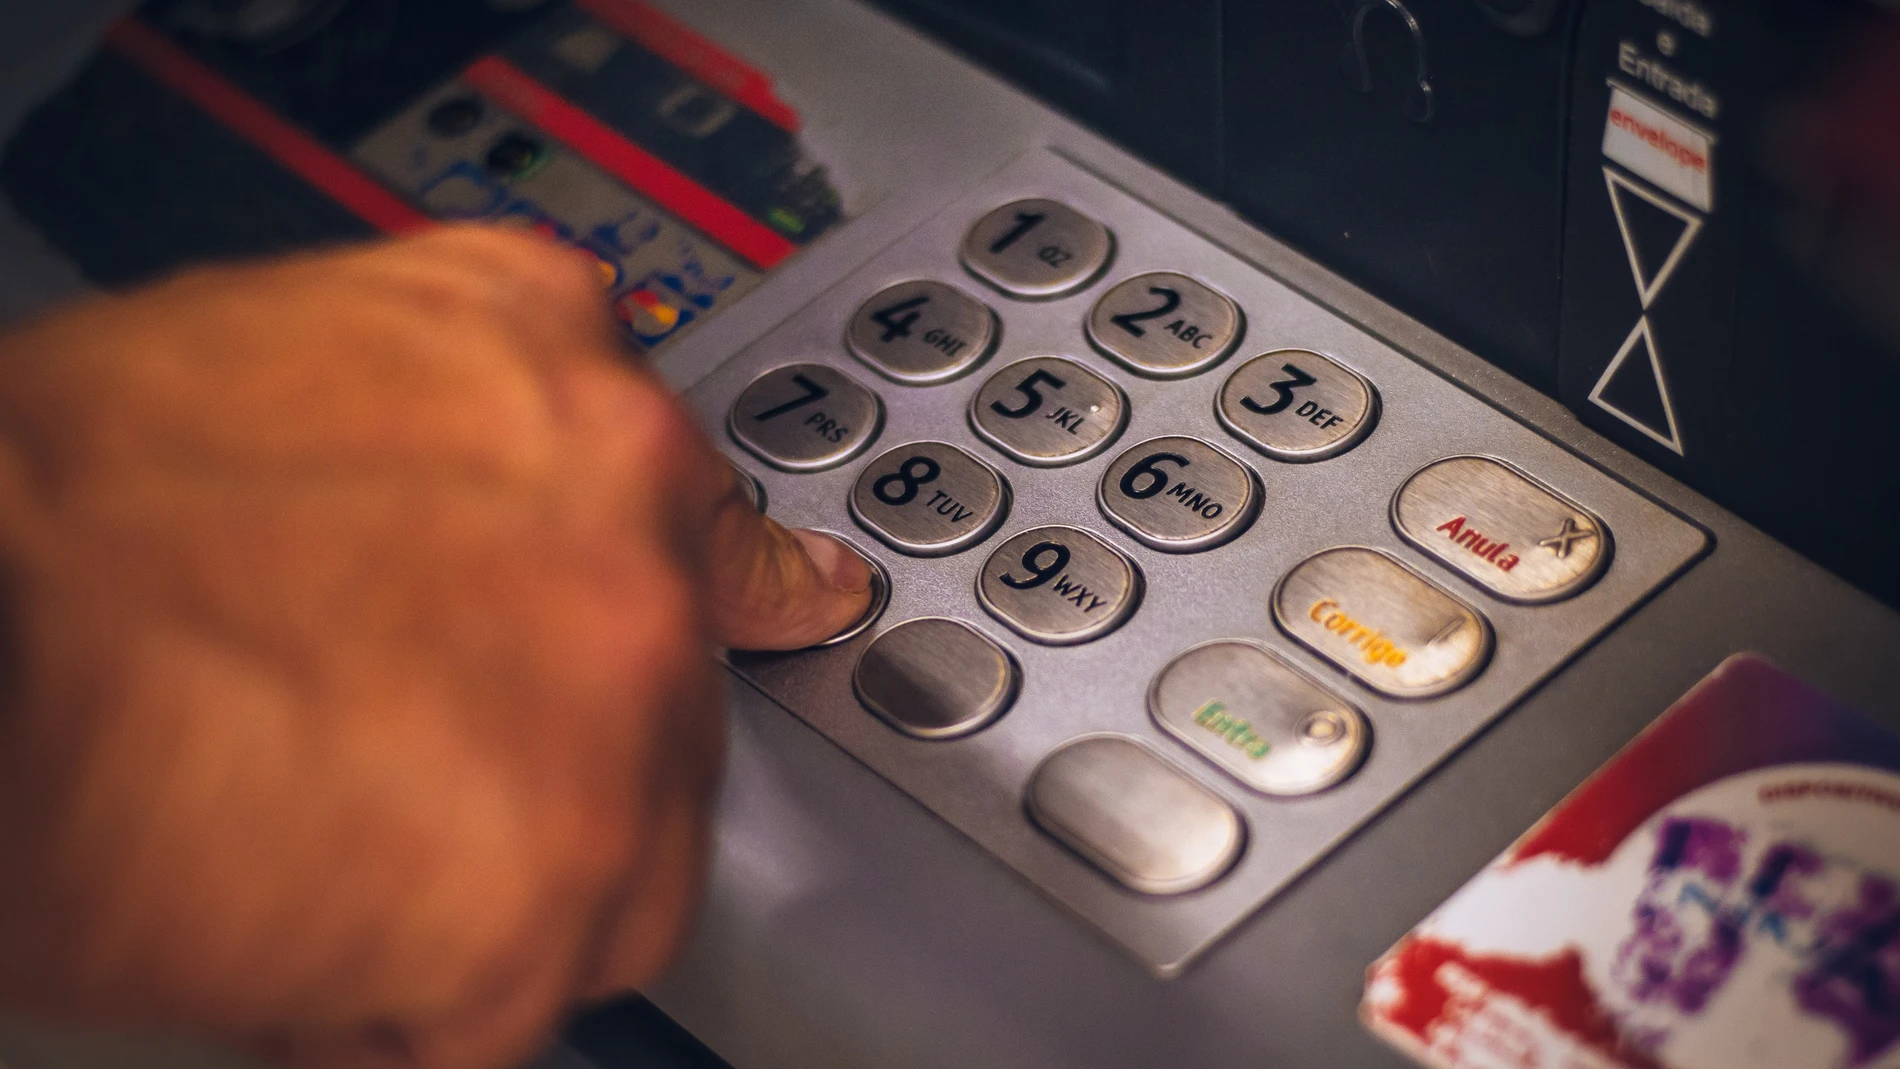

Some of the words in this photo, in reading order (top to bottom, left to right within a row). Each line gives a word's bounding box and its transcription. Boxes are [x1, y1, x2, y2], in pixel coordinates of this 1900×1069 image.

[1618, 42, 1718, 119] Entrada
[1610, 109, 1705, 171] envelope
[990, 213, 1044, 253] 1
[872, 296, 930, 343] 4
[924, 329, 967, 357] GHI
[1110, 287, 1181, 338] 2
[1163, 320, 1212, 349] ABC
[754, 374, 829, 421] 7
[804, 412, 849, 443] PRS
[990, 369, 1066, 418] 5
[1046, 406, 1085, 435] JKL
[1239, 363, 1318, 415] 3
[1295, 400, 1343, 430] DEF
[873, 456, 941, 506] 8
[926, 490, 973, 522] TUV
[1119, 452, 1190, 499] 6
[1166, 482, 1223, 519] MNO
[999, 540, 1070, 590] 9
[1053, 573, 1107, 613] WXY
[1436, 515, 1520, 573] Anula
[1308, 598, 1406, 668] Corrige
[1192, 698, 1271, 760] Entra
